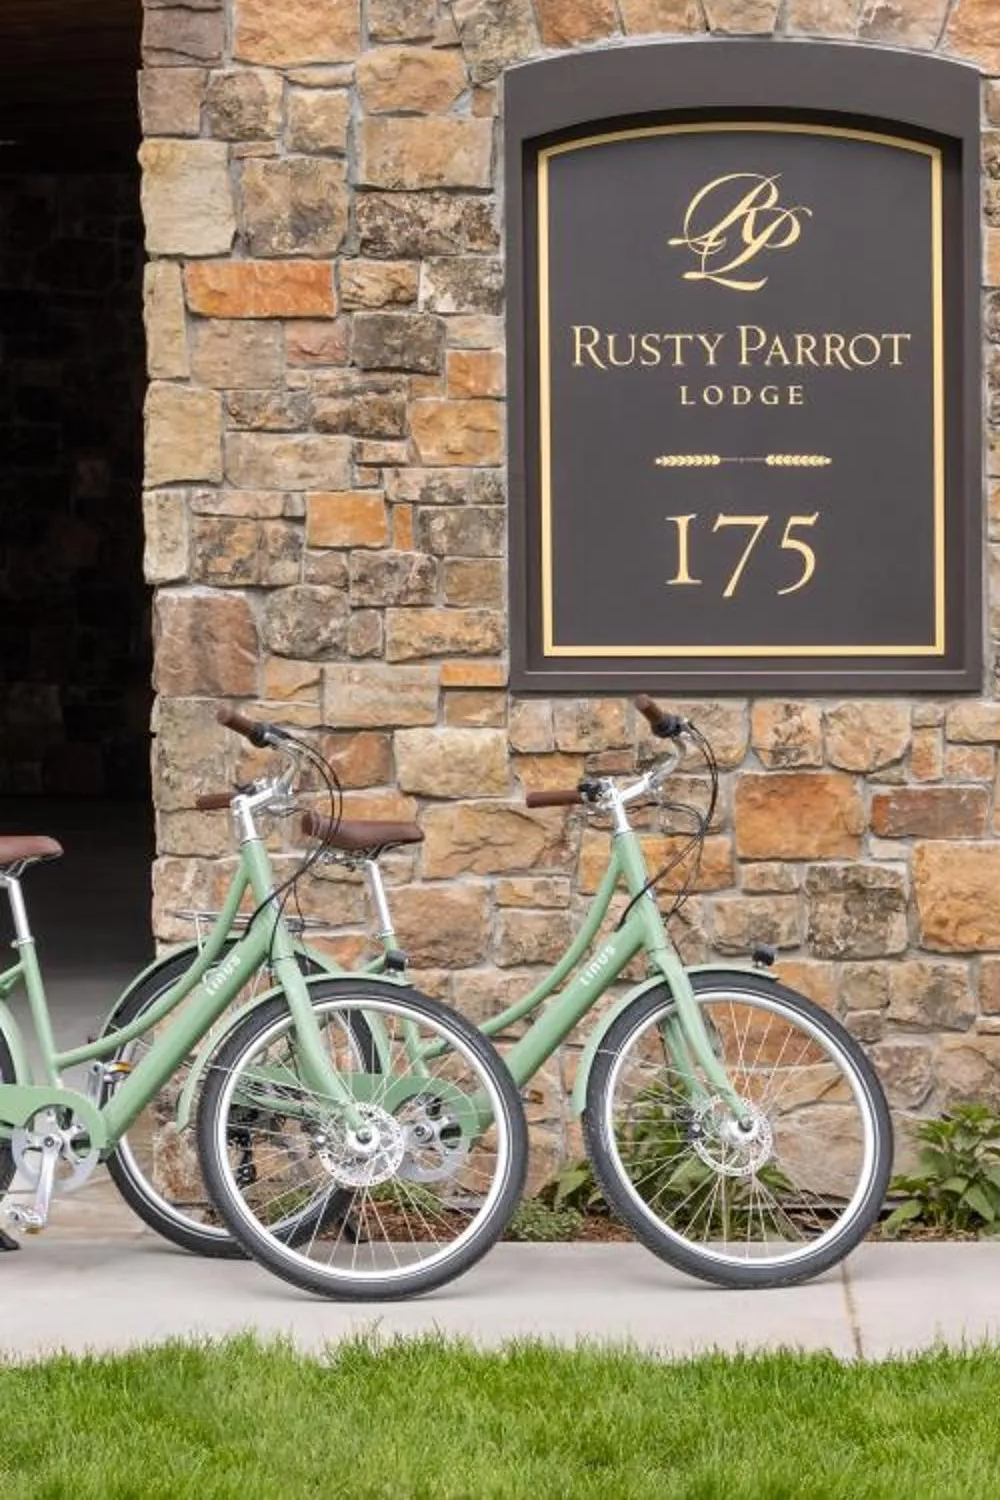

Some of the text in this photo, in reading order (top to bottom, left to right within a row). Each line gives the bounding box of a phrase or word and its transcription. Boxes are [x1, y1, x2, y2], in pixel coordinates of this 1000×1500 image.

[571, 324, 912, 371] RUSTY PARROT
[679, 385, 804, 406] LODGE
[666, 511, 821, 601] 175
